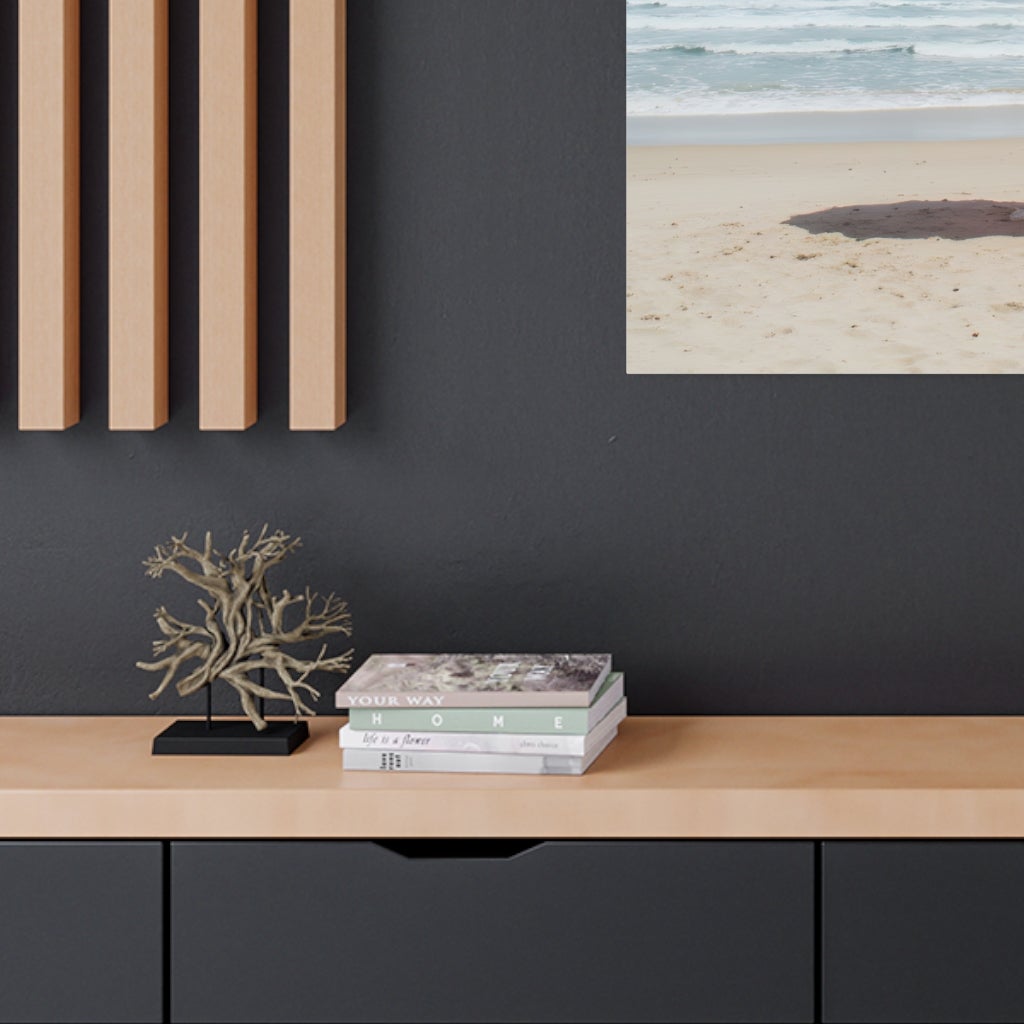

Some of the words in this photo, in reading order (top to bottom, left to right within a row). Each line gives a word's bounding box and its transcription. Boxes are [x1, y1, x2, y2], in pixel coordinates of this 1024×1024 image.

[348, 695, 399, 706] YOUR
[404, 695, 445, 706] WAY
[371, 712, 564, 730] HOME
[362, 732, 379, 747] life
[400, 733, 432, 749] flower
